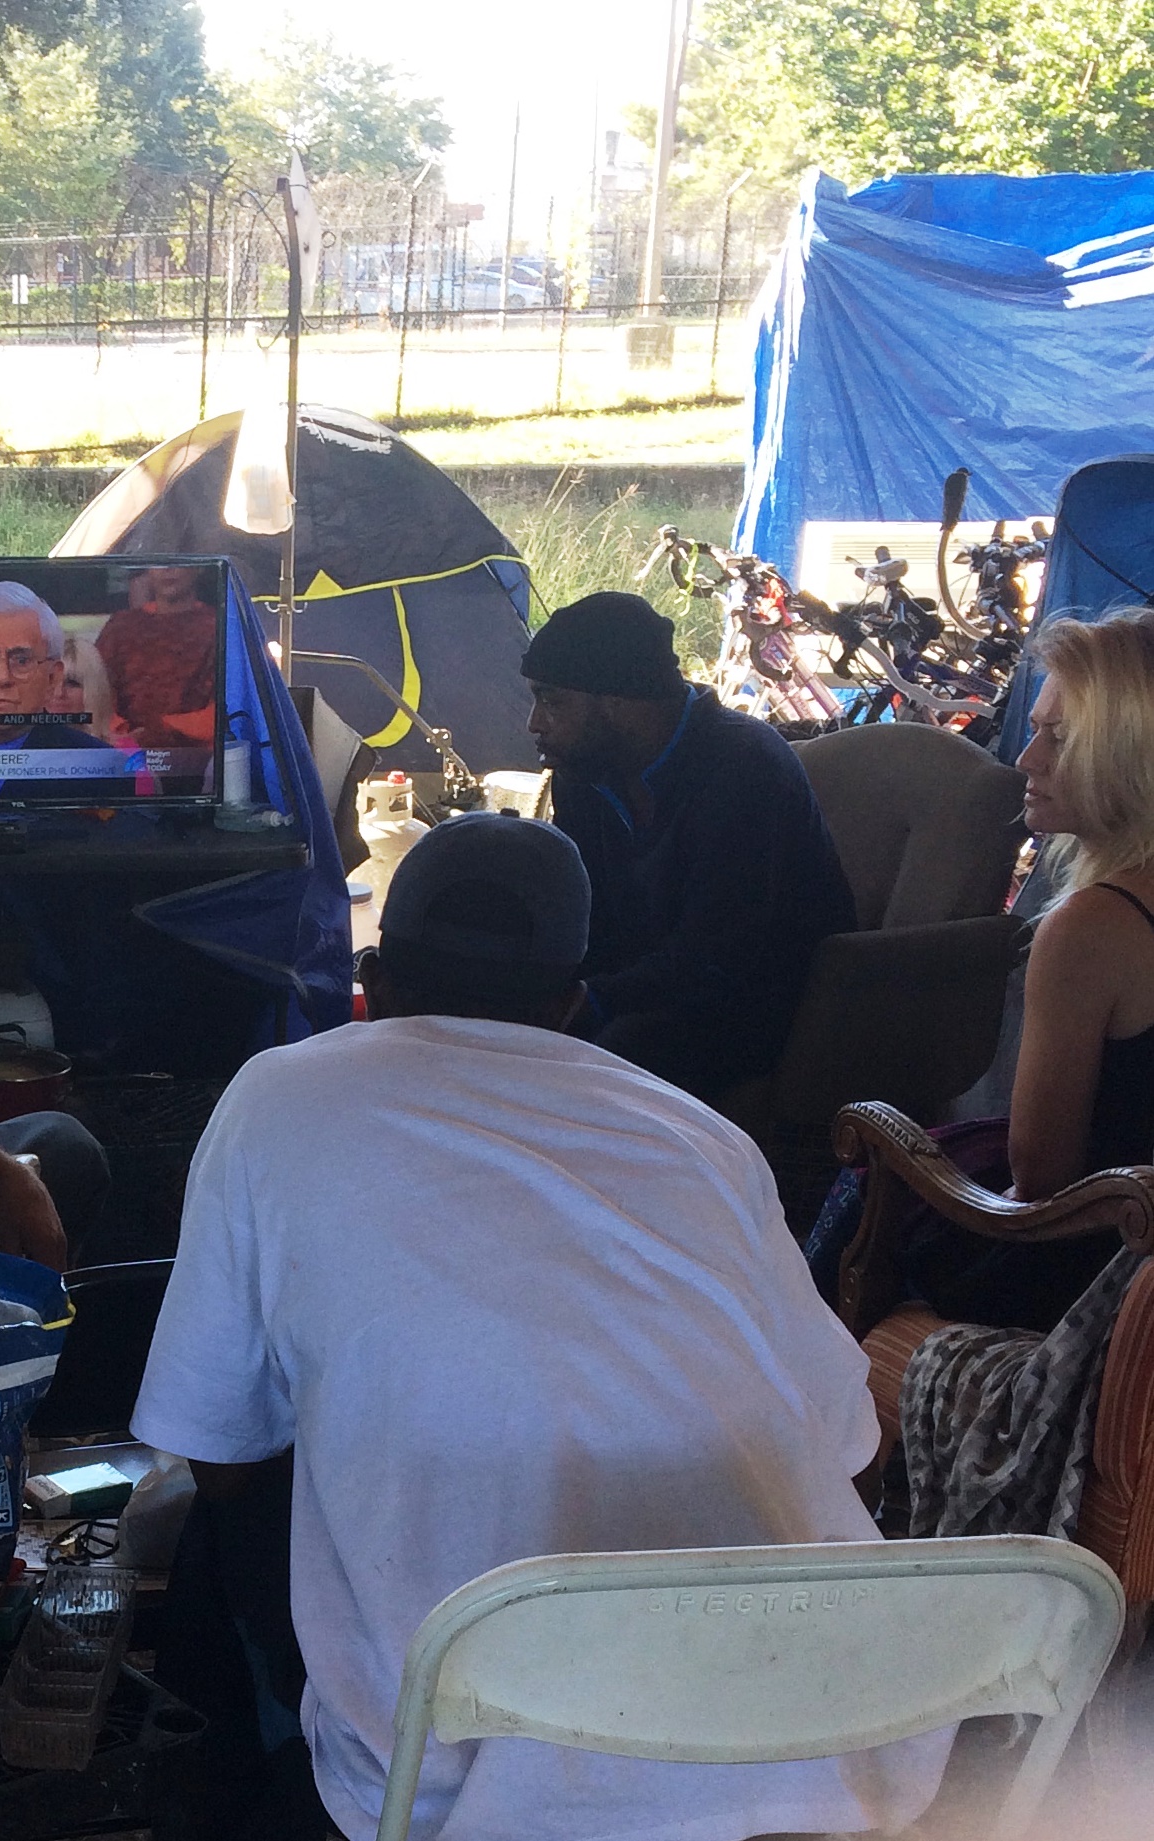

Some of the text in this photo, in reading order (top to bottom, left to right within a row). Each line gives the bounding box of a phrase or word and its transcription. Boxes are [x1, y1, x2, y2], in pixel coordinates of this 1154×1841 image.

[4, 714, 25, 724] AND
[31, 714, 74, 724] NEEDLE
[79, 714, 88, 723] P
[8, 767, 46, 776] PIONEER
[48, 766, 68, 775] PHIL
[70, 766, 116, 775] DONAHUE
[146, 764, 172, 772] TODAY
